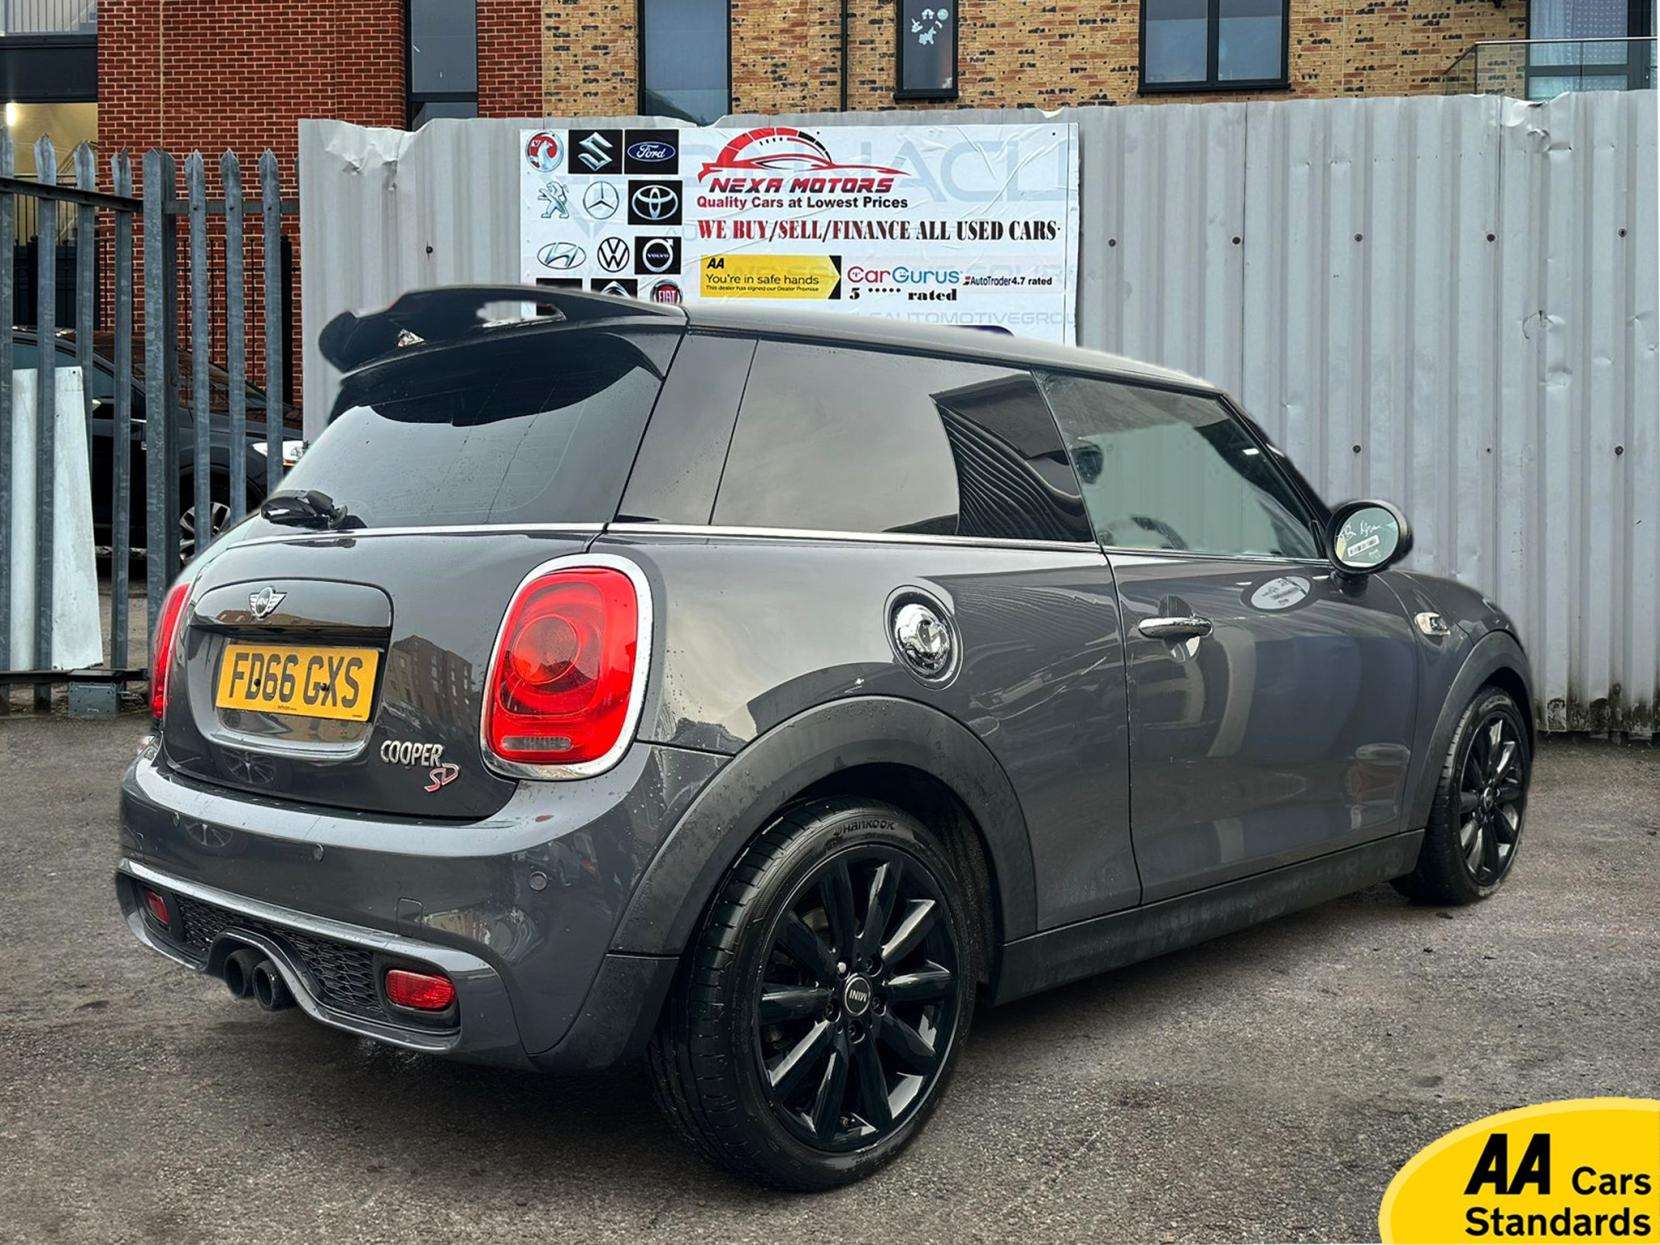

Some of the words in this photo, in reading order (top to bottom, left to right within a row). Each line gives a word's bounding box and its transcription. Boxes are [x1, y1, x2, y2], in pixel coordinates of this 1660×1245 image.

[637, 144, 666, 158] Ford
[709, 178, 784, 193] NEXA
[789, 178, 894, 193] MOTORS
[697, 196, 747, 210] Quality
[752, 196, 784, 208] Cars
[788, 197, 802, 208] at
[807, 197, 859, 208] Lowest
[863, 197, 908, 209] Prices
[697, 220, 727, 239] WE
[916, 221, 951, 240] ALL
[956, 221, 1004, 241] USED
[1008, 221, 1057, 241] CARS
[707, 257, 725, 269] AA
[706, 274, 741, 284] You're
[744, 274, 754, 284] in
[757, 274, 781, 285] safe
[784, 275, 819, 285] hands
[847, 266, 960, 284] CarGurus
[1028, 277, 1053, 286] rated
[849, 287, 861, 300] 5
[908, 288, 957, 301] rated
[228, 652, 298, 702] FD66
[303, 655, 363, 708] GXS
[380, 740, 444, 767] COOPER
[424, 763, 460, 792] SD
